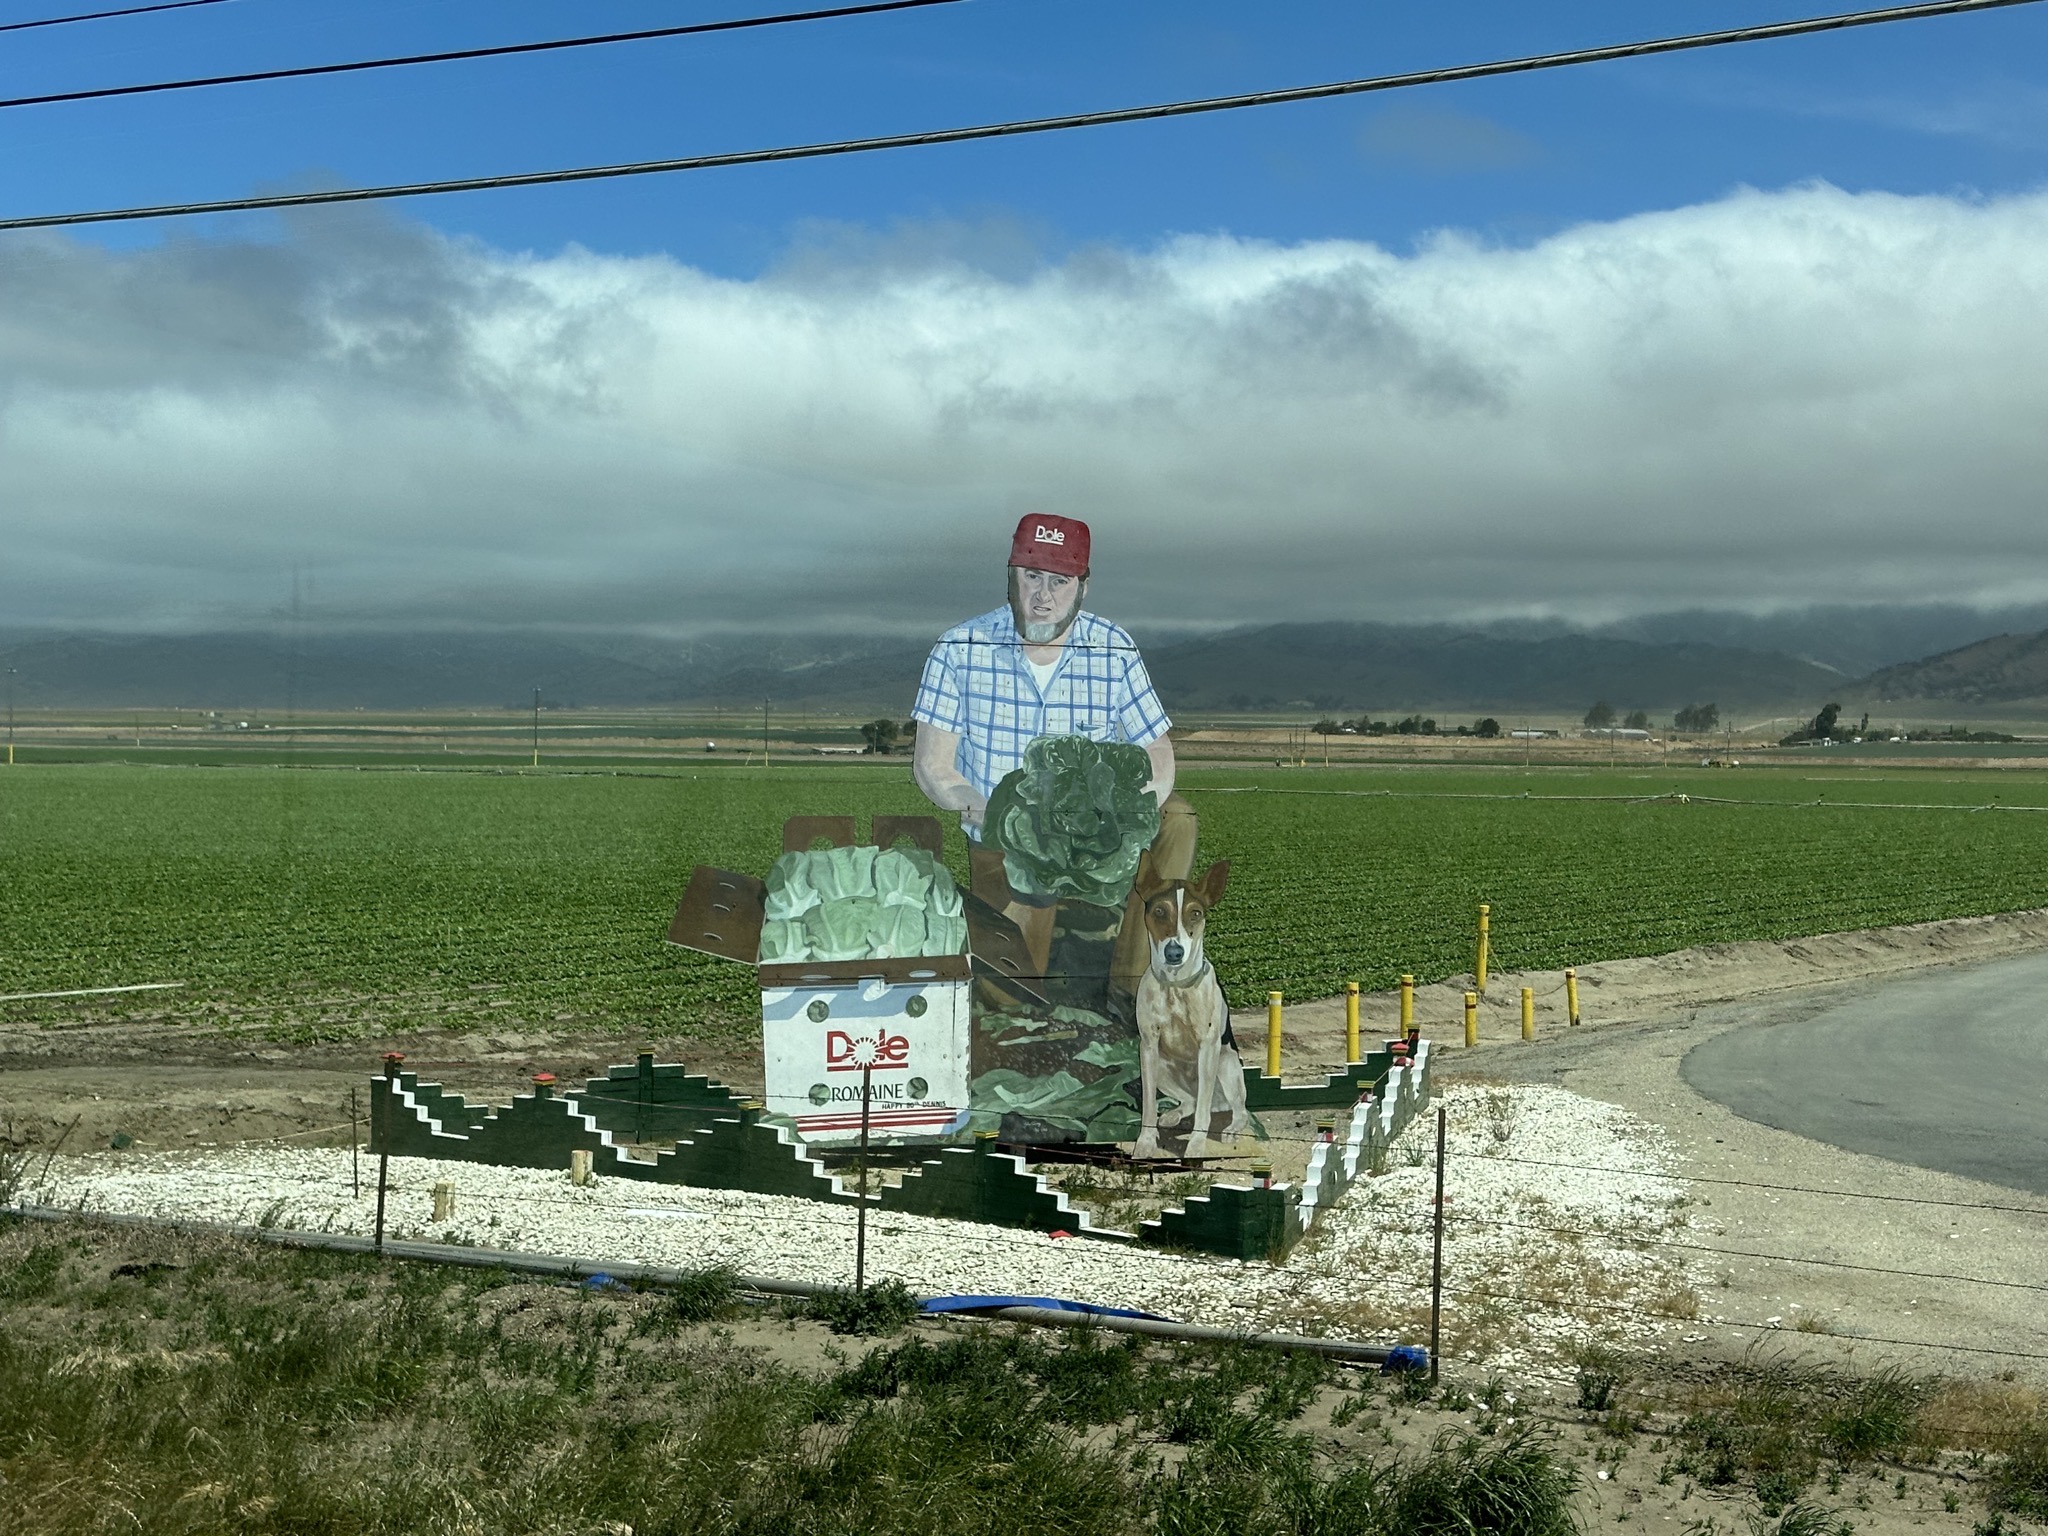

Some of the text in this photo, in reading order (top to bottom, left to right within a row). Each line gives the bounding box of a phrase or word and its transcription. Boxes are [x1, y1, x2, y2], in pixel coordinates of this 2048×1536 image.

[1035, 525, 1065, 542] Dole
[827, 1028, 910, 1063] Dole
[831, 1083, 904, 1102] ROMAINE
[881, 1102, 903, 1110] HAPPY
